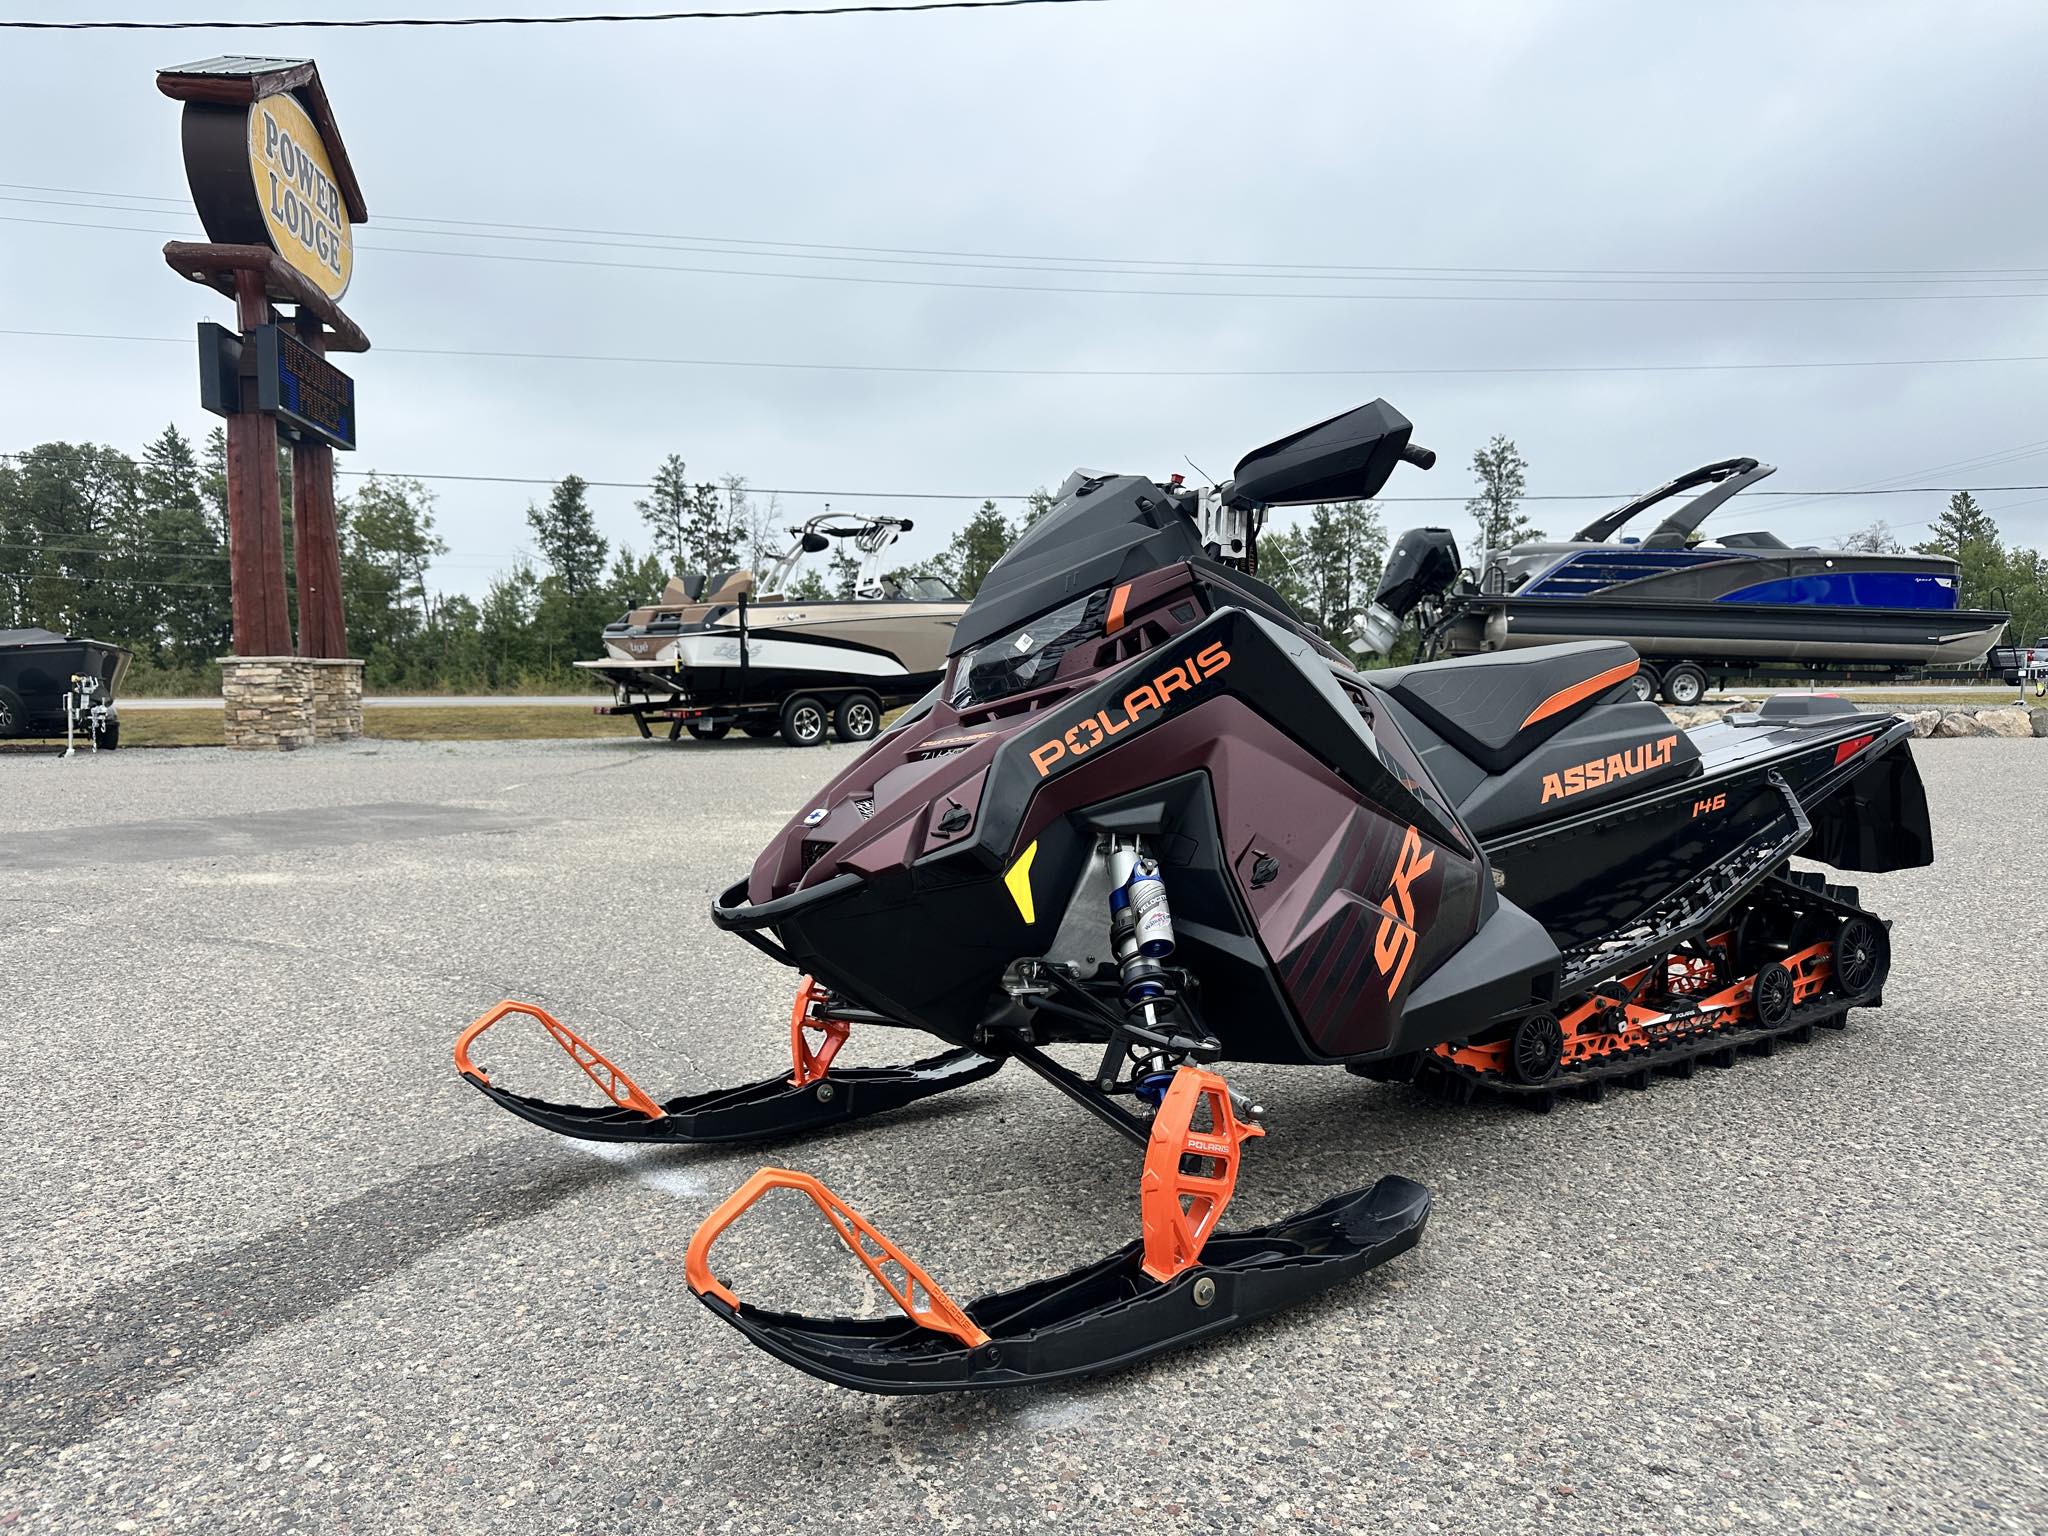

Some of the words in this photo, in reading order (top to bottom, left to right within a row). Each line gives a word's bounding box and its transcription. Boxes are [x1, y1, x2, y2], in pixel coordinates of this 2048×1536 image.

[264, 111, 342, 230] POWER
[269, 171, 341, 275] LODGE
[1031, 642, 1231, 776] POLARIS
[919, 731, 996, 748] SWITCHBAC
[1541, 735, 1678, 804] ASSAULT
[1692, 793, 1727, 818] 146
[1138, 894, 1168, 914] VELOCIT
[1187, 1138, 1230, 1154] POLARIS
[932, 1286, 972, 1330] POLARIS
